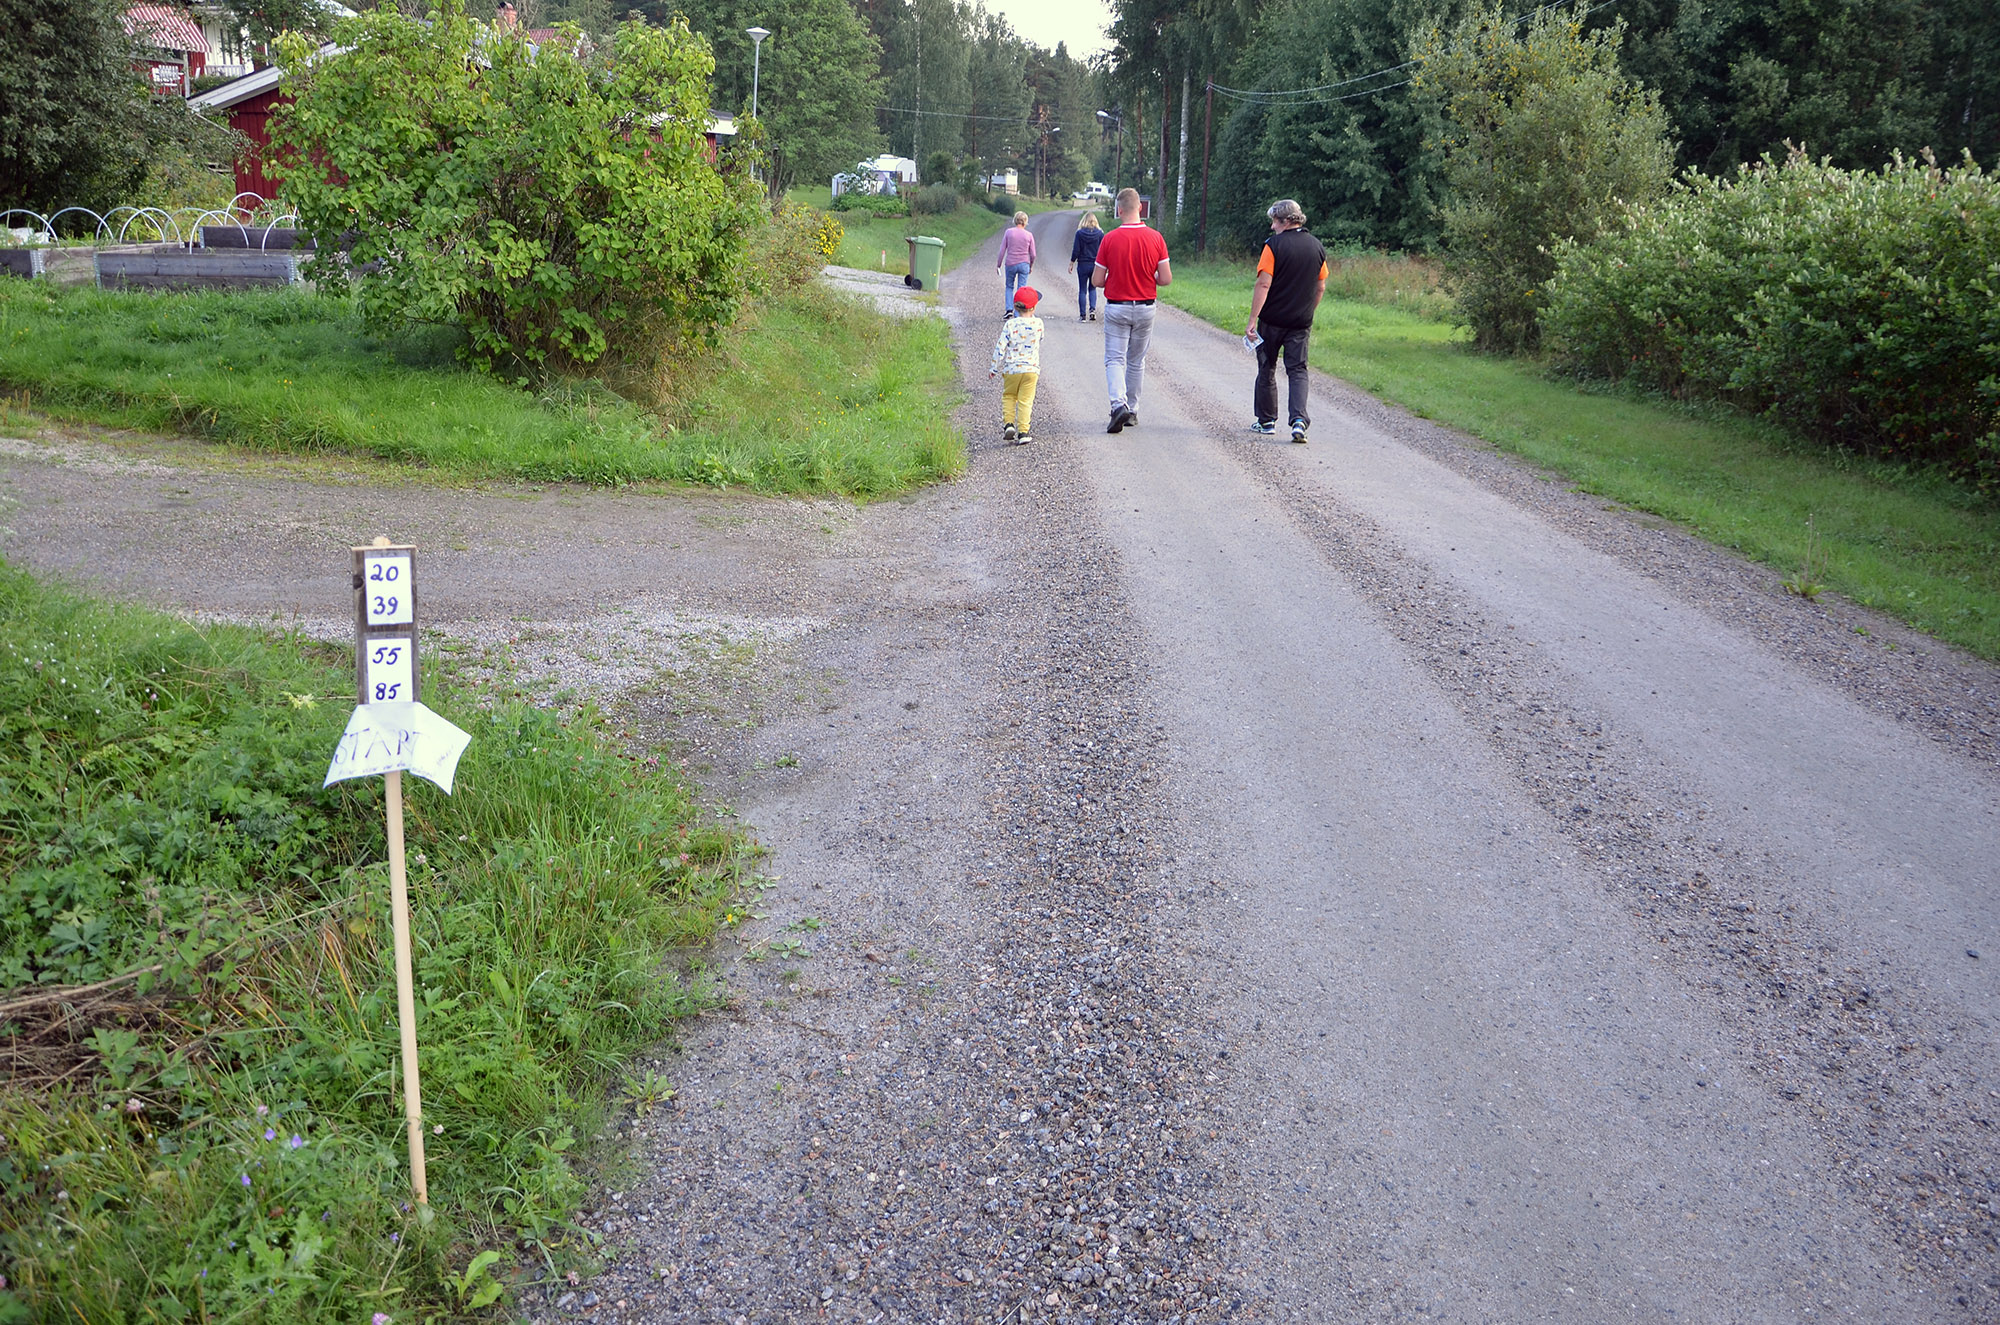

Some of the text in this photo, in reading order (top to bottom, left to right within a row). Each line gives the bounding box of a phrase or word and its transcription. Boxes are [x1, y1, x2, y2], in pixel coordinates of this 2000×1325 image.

[370, 564, 399, 582] 20
[373, 596, 398, 616] 39
[372, 647, 402, 665] 55
[375, 682, 401, 700] 85
[334, 728, 430, 765] START
